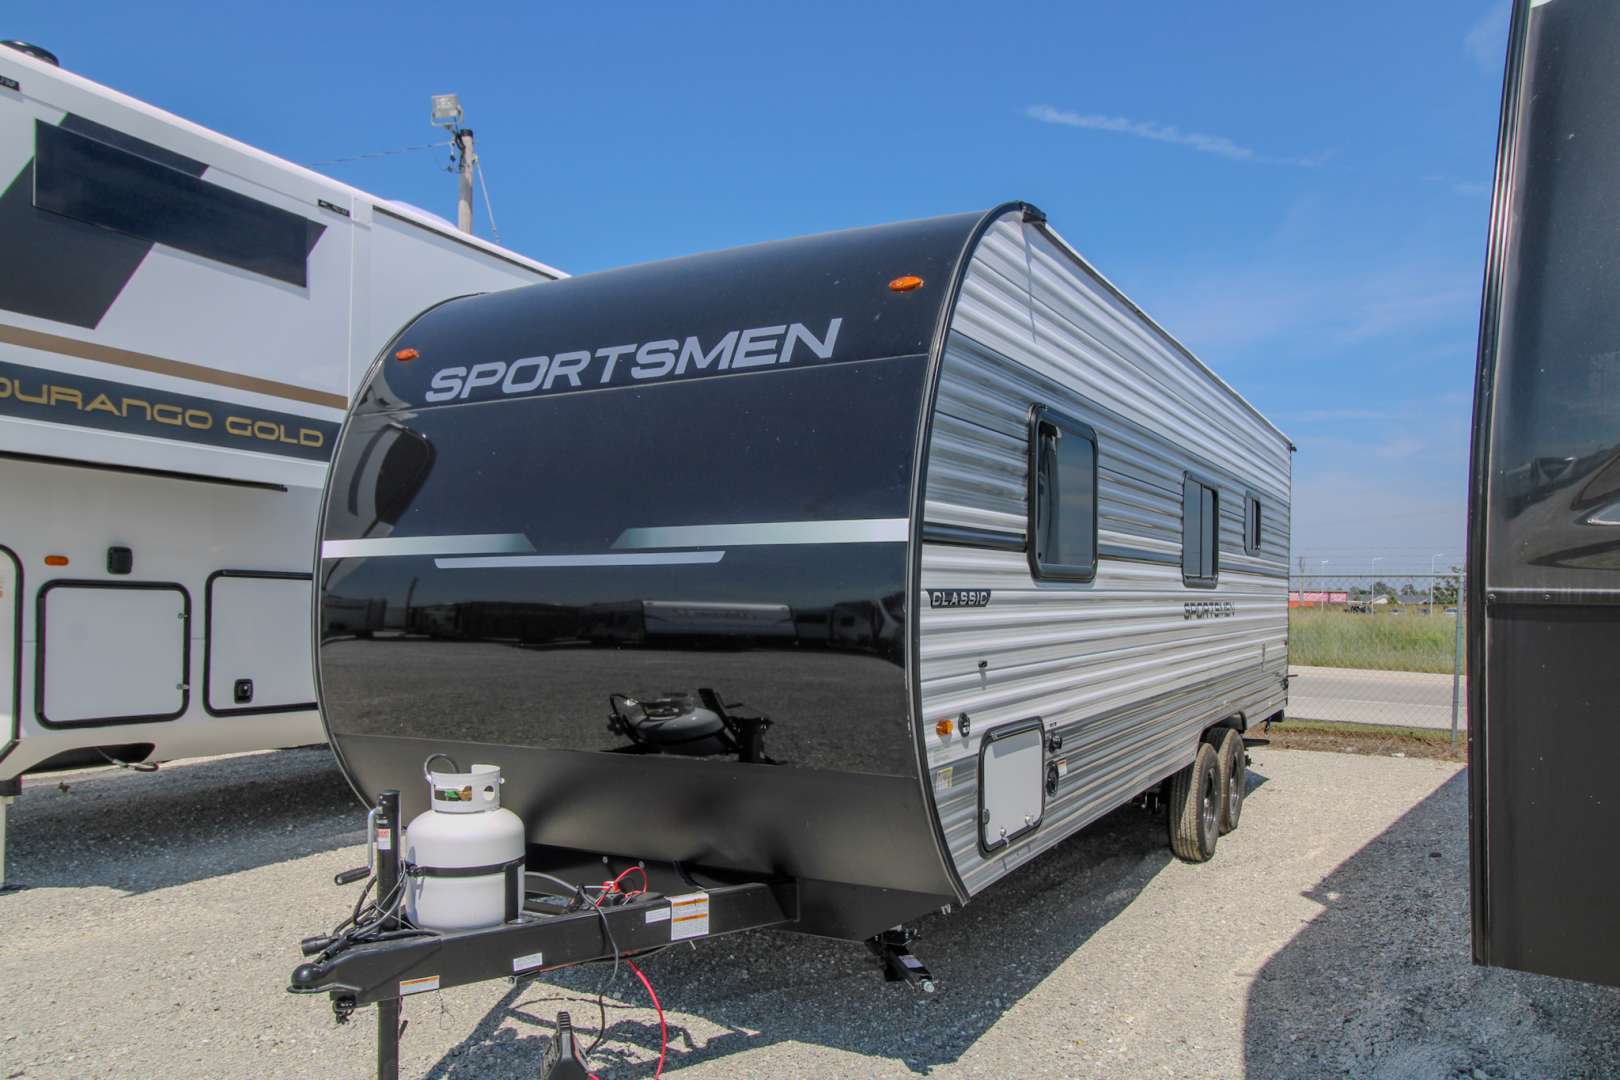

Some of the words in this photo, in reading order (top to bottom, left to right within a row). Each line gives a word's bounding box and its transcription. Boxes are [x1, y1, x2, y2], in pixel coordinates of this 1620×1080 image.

[425, 317, 843, 402] SPORTSMEN
[225, 416, 324, 447] GOLD
[932, 591, 988, 606] CLASSIC
[1184, 601, 1236, 619] SPORTSMEN
